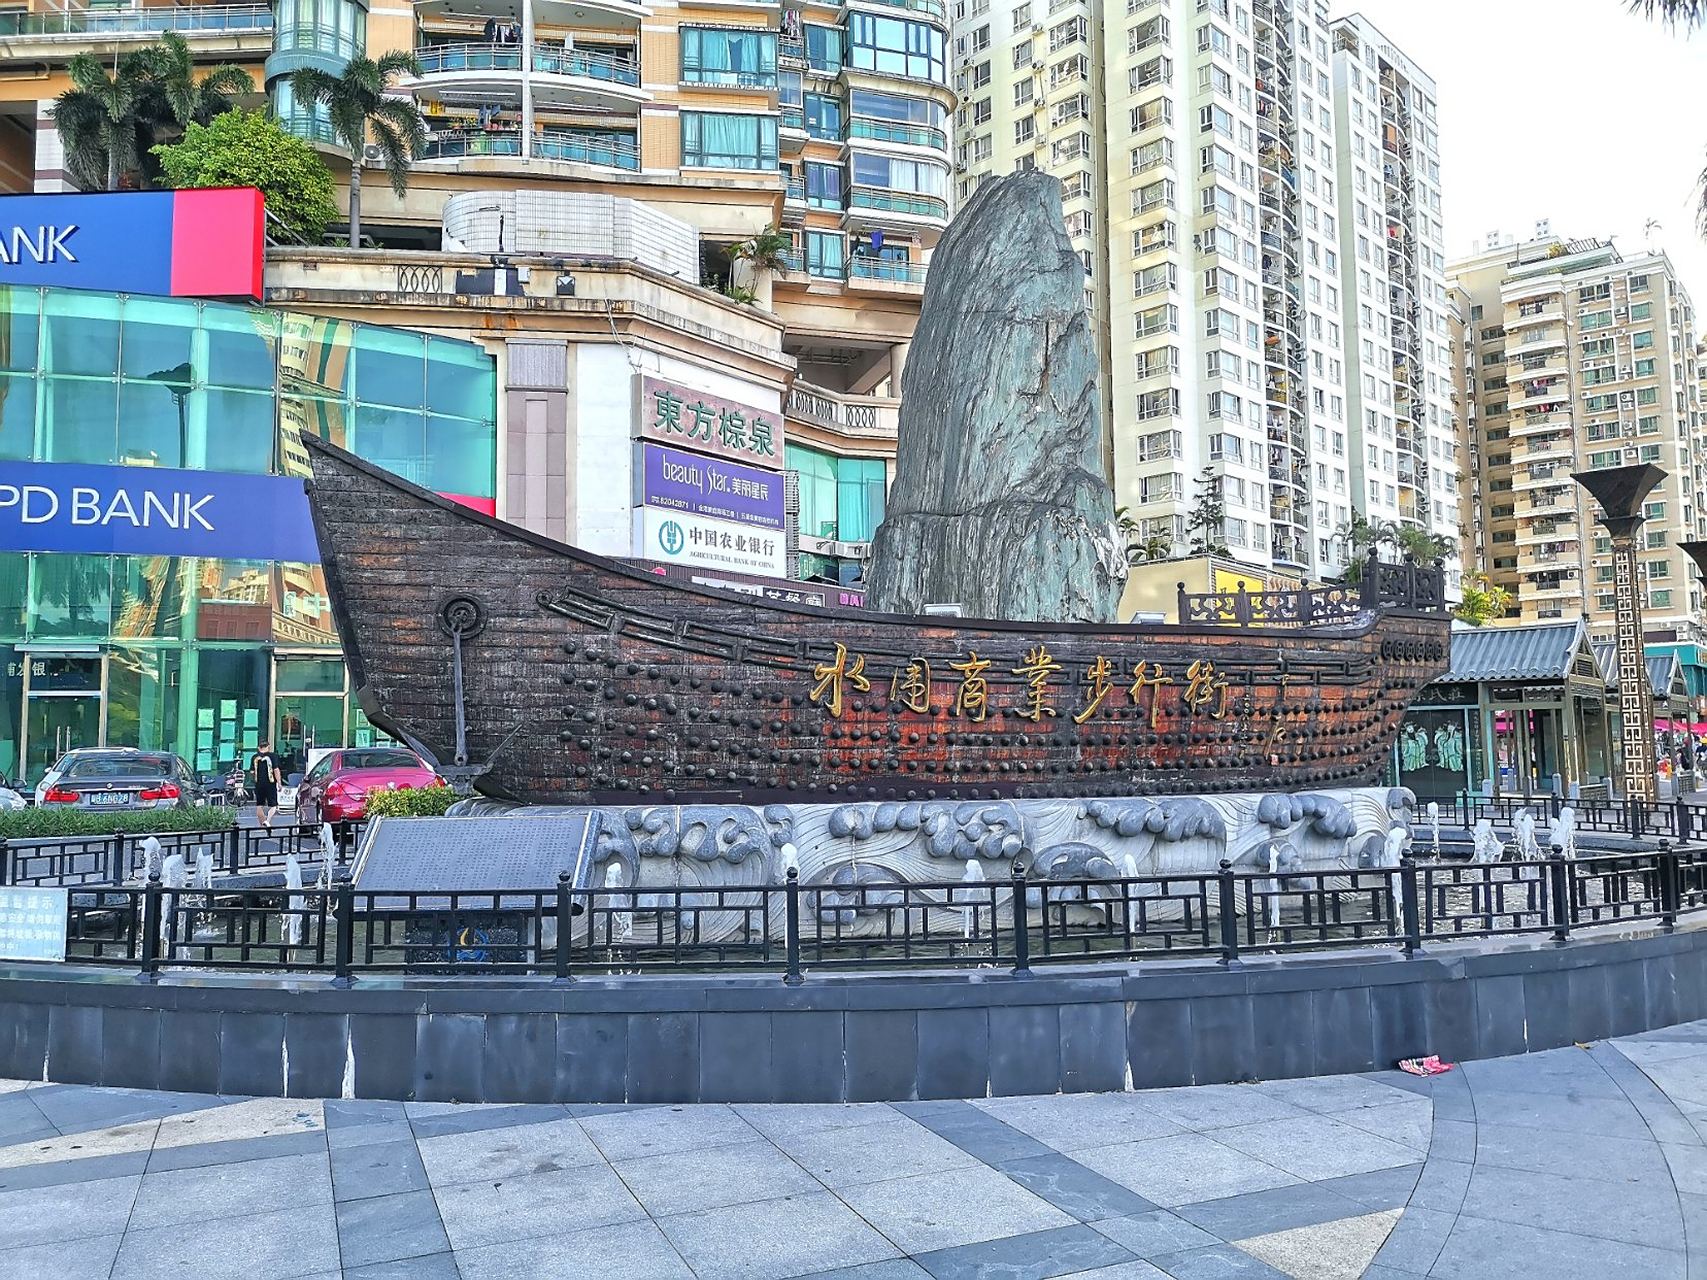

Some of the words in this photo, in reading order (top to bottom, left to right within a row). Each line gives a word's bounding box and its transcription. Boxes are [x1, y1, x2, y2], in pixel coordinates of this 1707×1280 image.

[653, 389, 775, 457] 東方棕泉
[662, 454, 704, 495] beauty
[71, 487, 215, 531] BANK
[689, 526, 775, 556] 中国农业银行
